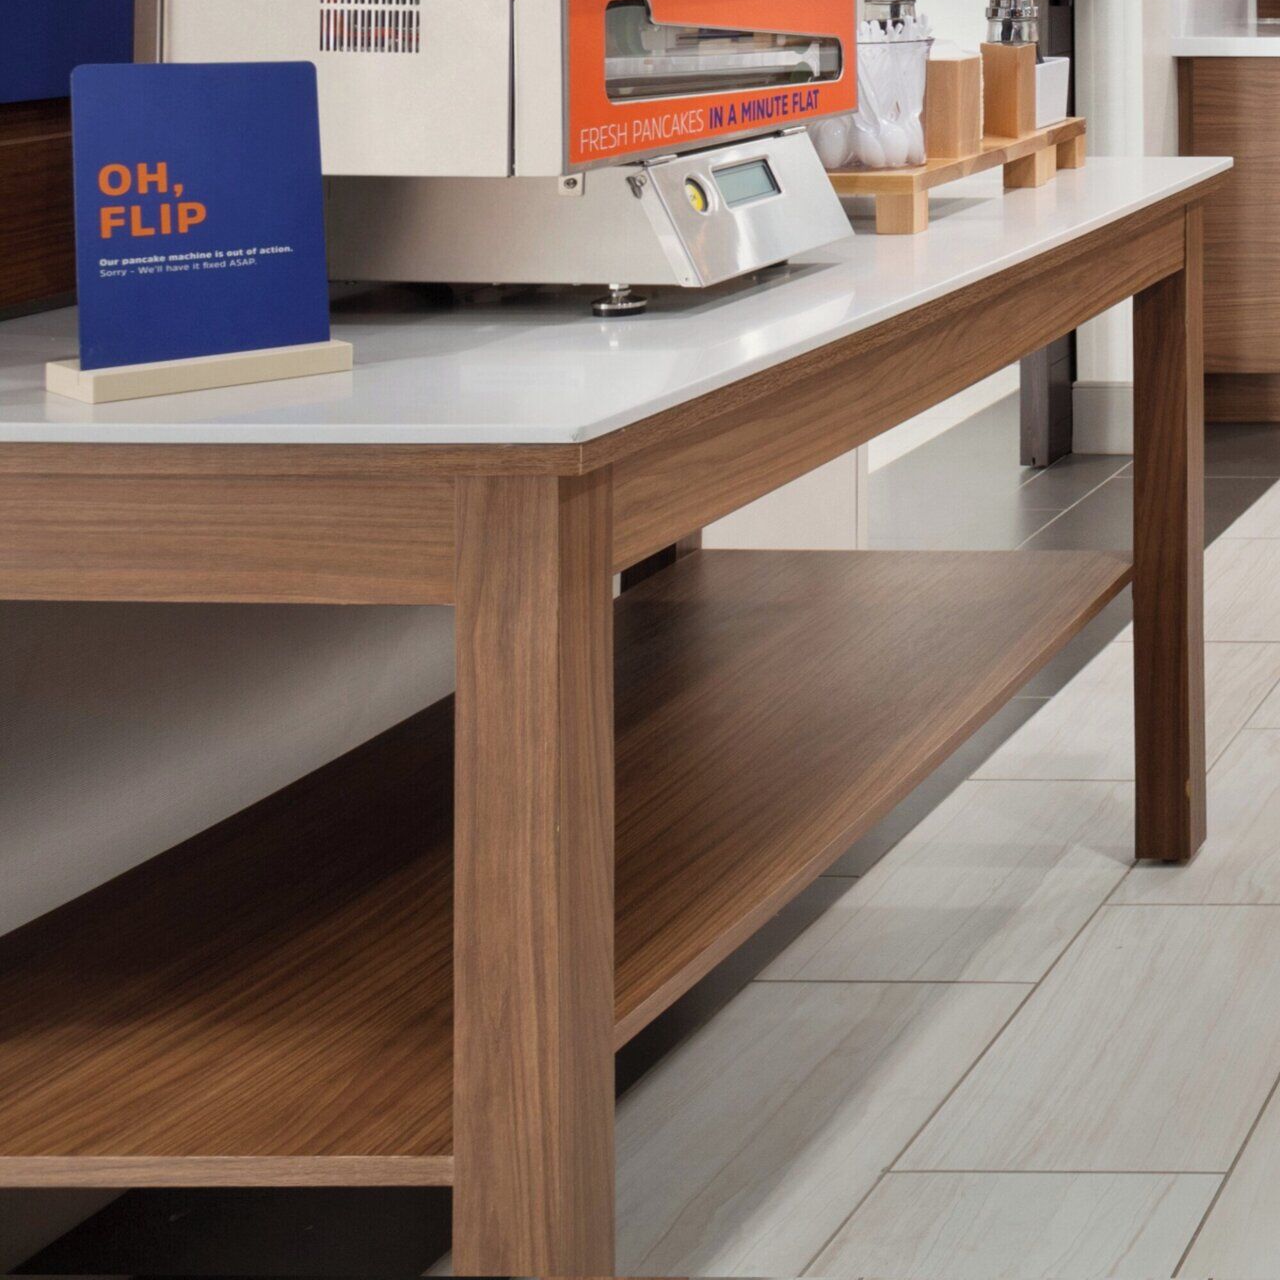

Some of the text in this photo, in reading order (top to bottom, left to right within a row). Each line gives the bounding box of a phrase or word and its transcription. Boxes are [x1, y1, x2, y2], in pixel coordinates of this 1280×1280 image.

[580, 89, 819, 154] FRESH PANCAKES IN A MINUTE FLAT
[98, 162, 184, 198] OH,
[100, 201, 207, 239] FLIP
[99, 268, 127, 278] Sorry
[138, 264, 163, 274] We'll
[166, 262, 190, 273] have
[192, 261, 200, 270] it
[203, 259, 226, 269] fixed
[229, 258, 257, 268] ASAP.
[100, 245, 294, 267] Our pancake machine is out of action.
